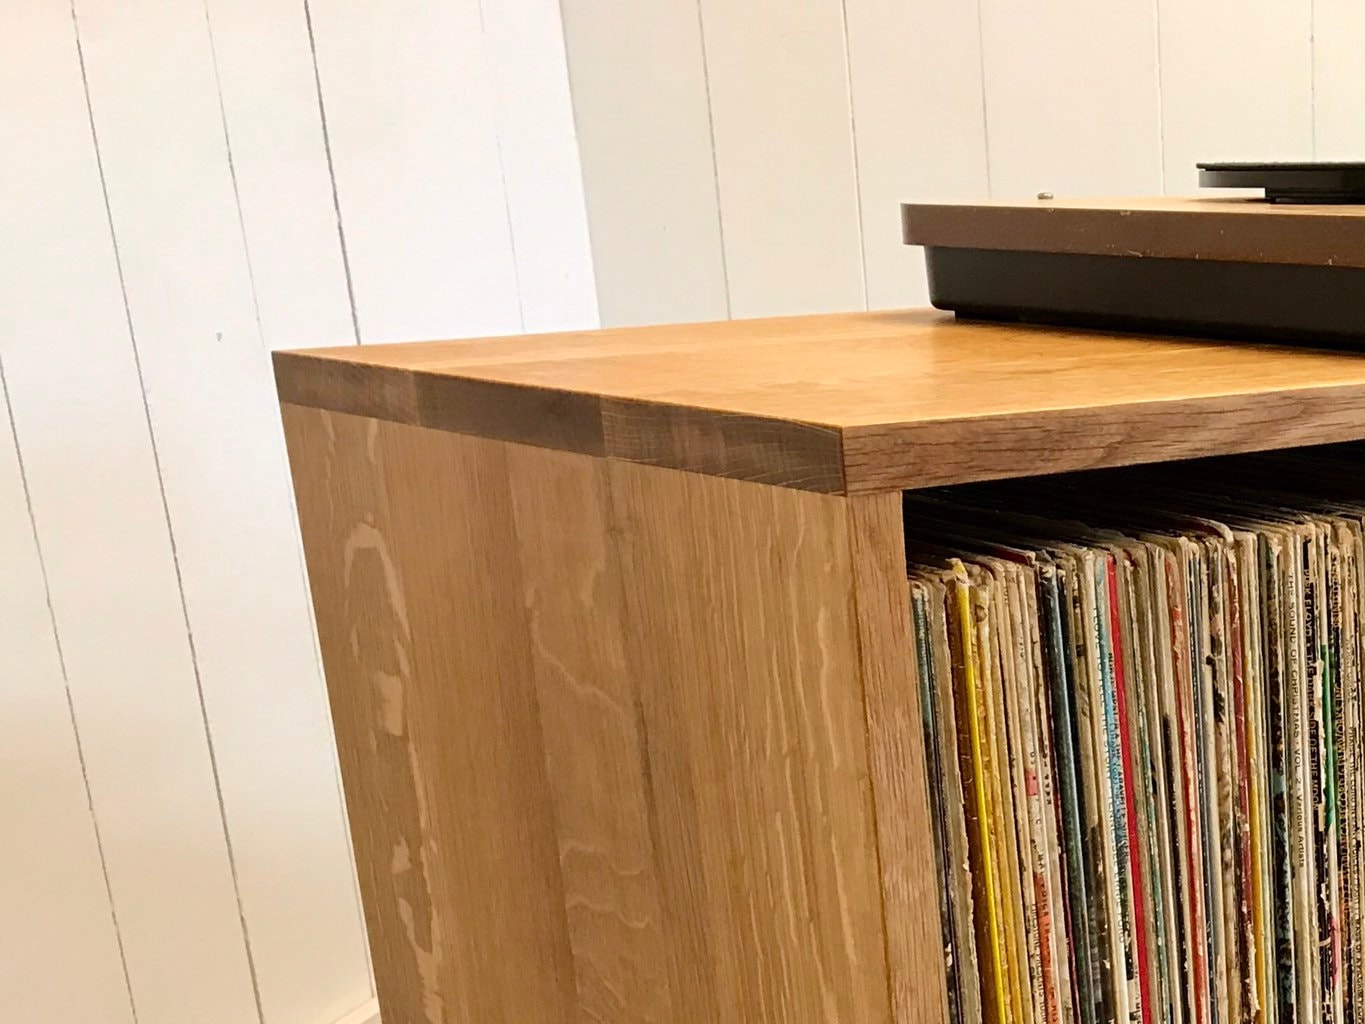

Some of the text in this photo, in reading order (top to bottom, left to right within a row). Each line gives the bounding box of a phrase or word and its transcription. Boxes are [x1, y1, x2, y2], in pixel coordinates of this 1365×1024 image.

[1285, 572, 1294, 597] THE
[1303, 567, 1311, 596] PINK
[1287, 601, 1296, 645] SOUND
[1304, 597, 1313, 637] FLOYD
[1289, 647, 1297, 665] OF
[1306, 652, 1314, 676] THE
[1290, 668, 1300, 739] CHRISTMAS
[1309, 737, 1317, 754] OF
[1294, 775, 1302, 786] 2
[1310, 754, 1318, 778] THE
[1311, 778, 1319, 812] MOON
[1295, 792, 1304, 833] Various
[1297, 833, 1306, 869] Artists
